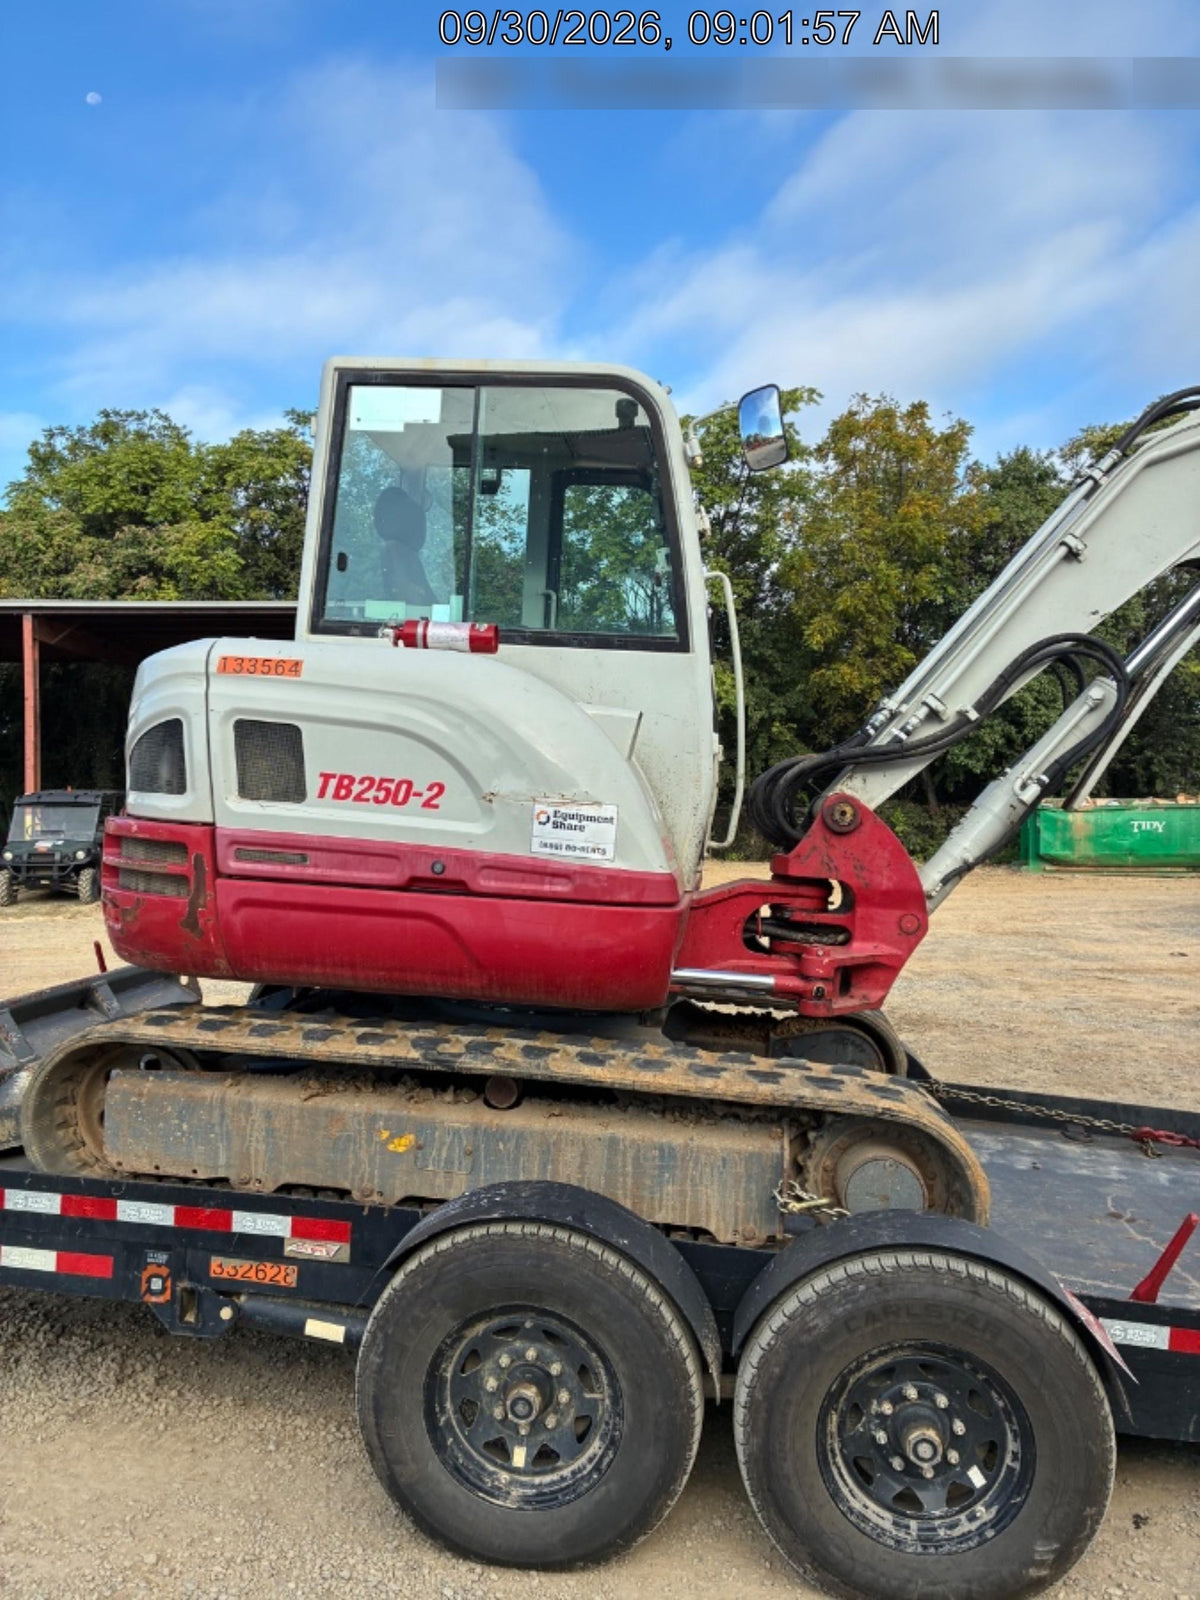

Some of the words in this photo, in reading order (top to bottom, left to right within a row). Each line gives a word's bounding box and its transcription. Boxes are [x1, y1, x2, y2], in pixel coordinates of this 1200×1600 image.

[221, 657, 300, 677] 133564
[317, 771, 446, 810] TB250-2
[553, 809, 614, 824] Equipment
[552, 820, 586, 832] Share
